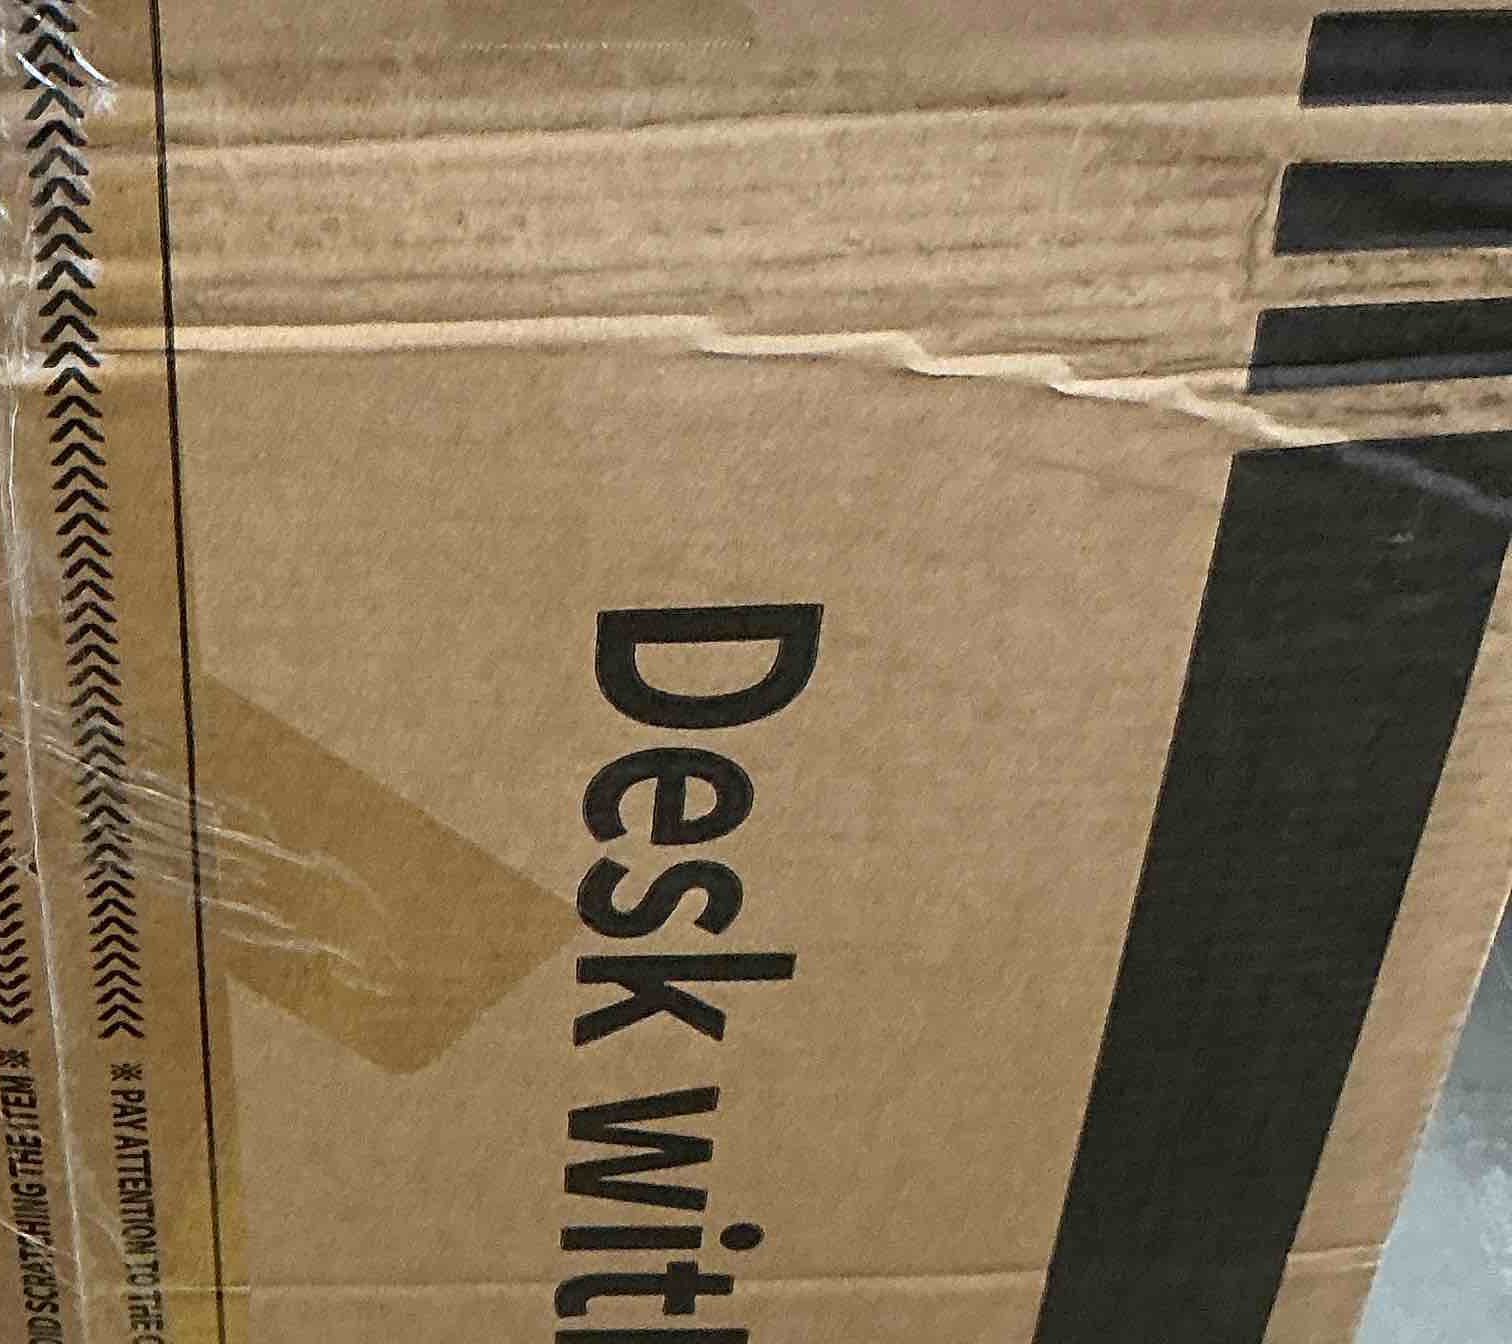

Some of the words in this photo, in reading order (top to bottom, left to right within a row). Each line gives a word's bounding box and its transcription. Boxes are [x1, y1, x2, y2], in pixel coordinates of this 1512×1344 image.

[573, 602, 825, 1047] Desk
[110, 1088, 148, 1132] PAY
[5, 1133, 45, 1179] THE
[113, 1134, 158, 1254] ATTENTION
[124, 1259, 161, 1286] TO
[128, 1290, 164, 1331] THE
